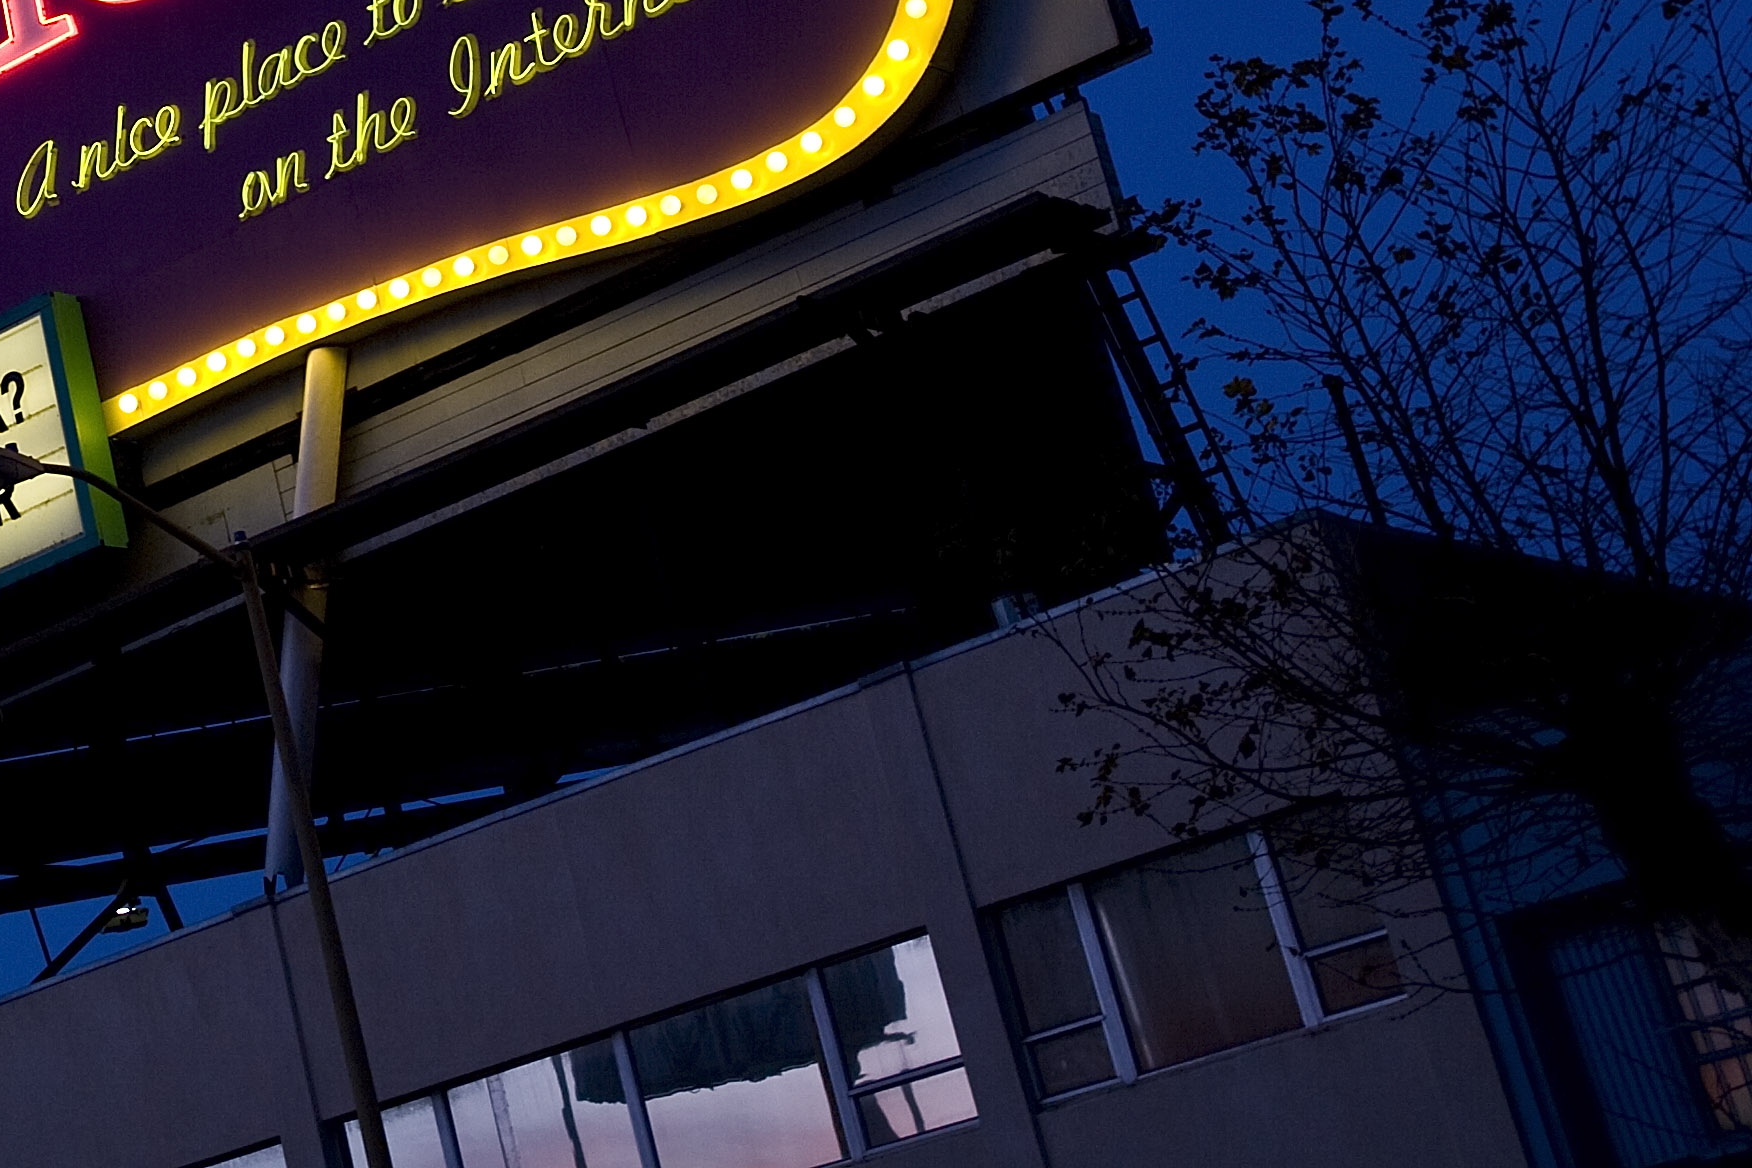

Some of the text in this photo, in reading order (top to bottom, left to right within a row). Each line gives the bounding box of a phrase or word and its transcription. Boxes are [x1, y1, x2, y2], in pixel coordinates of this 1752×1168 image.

[16, 140, 59, 218] A
[198, 19, 346, 152] place
[238, 150, 311, 220] on
[324, 90, 418, 181] the
